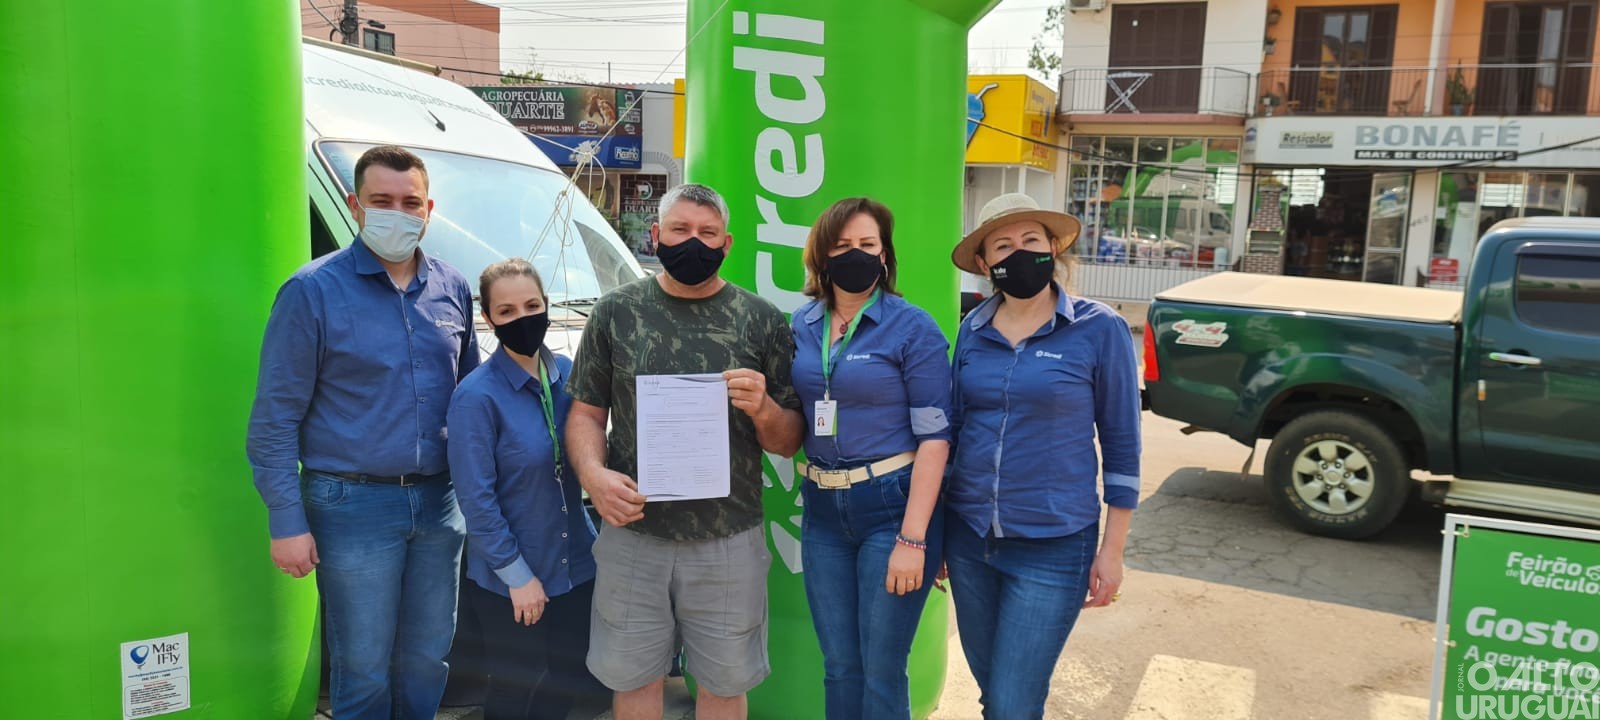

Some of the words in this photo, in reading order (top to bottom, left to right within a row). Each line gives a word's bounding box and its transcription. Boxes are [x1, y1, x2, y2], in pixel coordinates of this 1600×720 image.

[481, 89, 565, 102] AGROPECUÁRIA
[1355, 120, 1521, 147] BONAFÉ
[1358, 151, 1391, 159] MAT.
[1394, 151, 1412, 159] DE
[1506, 551, 1582, 577] Feirão
[1505, 569, 1520, 578] de
[1519, 570, 1600, 595] Veículo
[1465, 606, 1600, 653] Gosto
[152, 642, 180, 654] Mac
[1464, 645, 1480, 661] A
[1484, 650, 1550, 673] gente
